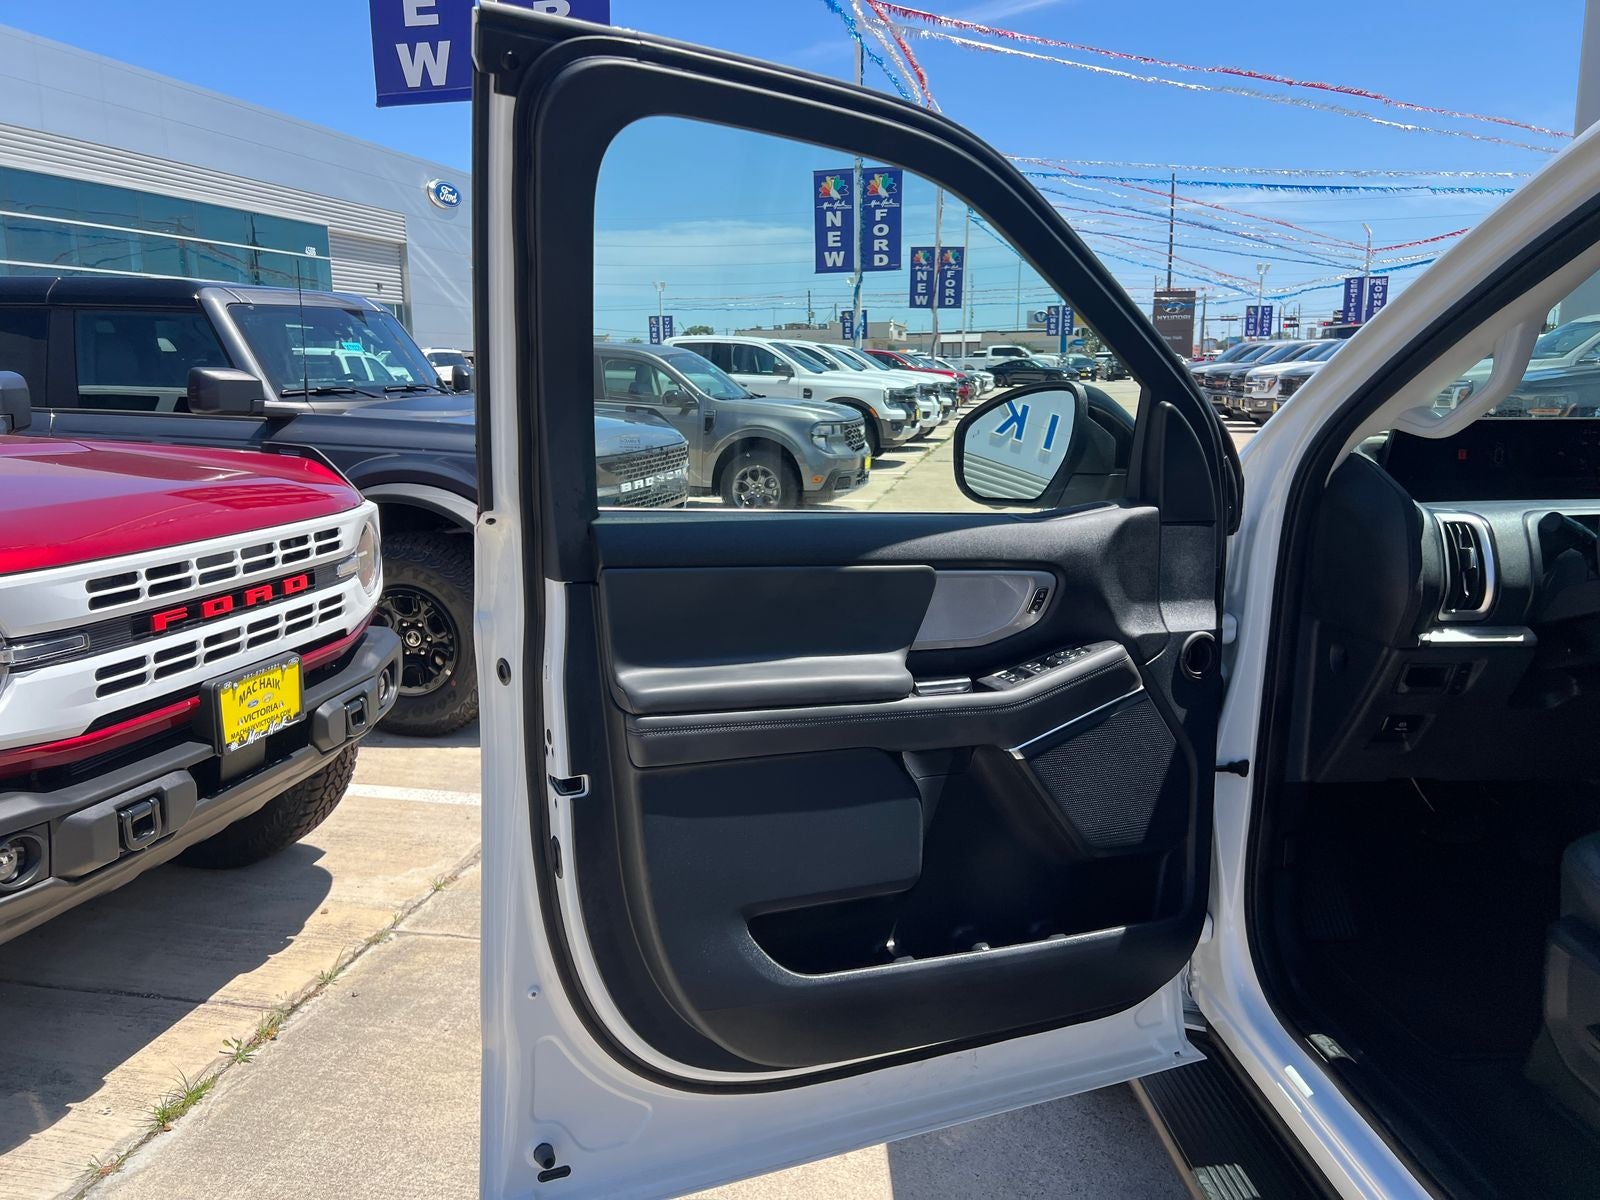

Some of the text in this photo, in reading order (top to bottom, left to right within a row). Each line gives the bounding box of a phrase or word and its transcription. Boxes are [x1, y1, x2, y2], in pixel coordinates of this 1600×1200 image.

[824, 211, 845, 267] NEW
[873, 209, 889, 266] FORD
[915, 271, 928, 305] NEW
[945, 271, 955, 305] FORD
[1370, 278, 1388, 286] PRE
[1347, 279, 1358, 321] CERTIFIED
[651, 327, 659, 343] NEW
[1049, 318, 1057, 335] NEW
[1247, 317, 1255, 335] NEW
[152, 574, 308, 632] FORD
[239, 681, 258, 707] MAC
[259, 677, 281, 690] HAIK
[243, 702, 279, 724] VICTORIA
